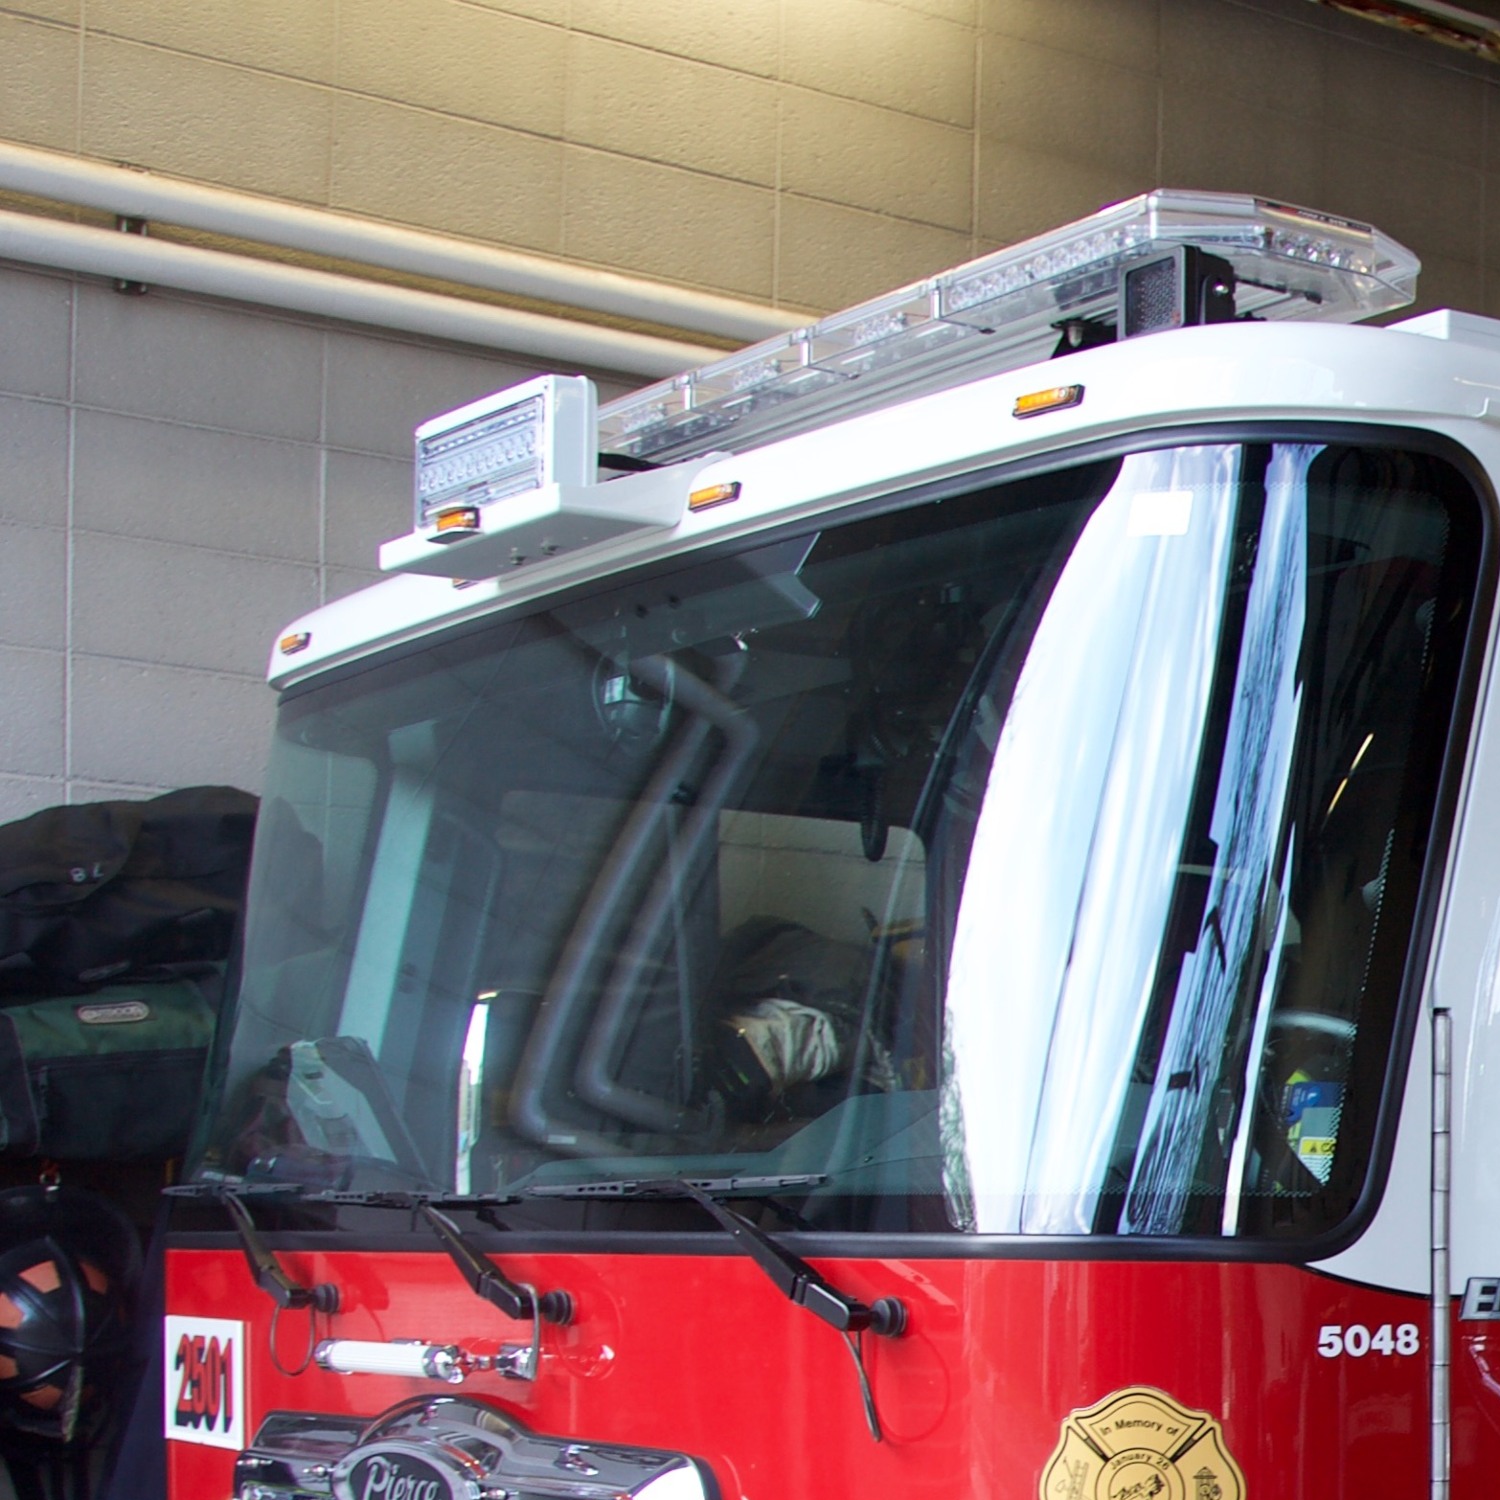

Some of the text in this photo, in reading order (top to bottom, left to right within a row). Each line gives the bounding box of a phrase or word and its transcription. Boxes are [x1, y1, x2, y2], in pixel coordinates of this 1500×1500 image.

[1317, 1323, 1420, 1357] 5048
[174, 1333, 233, 1433] 2501
[1101, 1419, 1180, 1437] In Memory of
[1109, 1453, 1171, 1471] January 26
